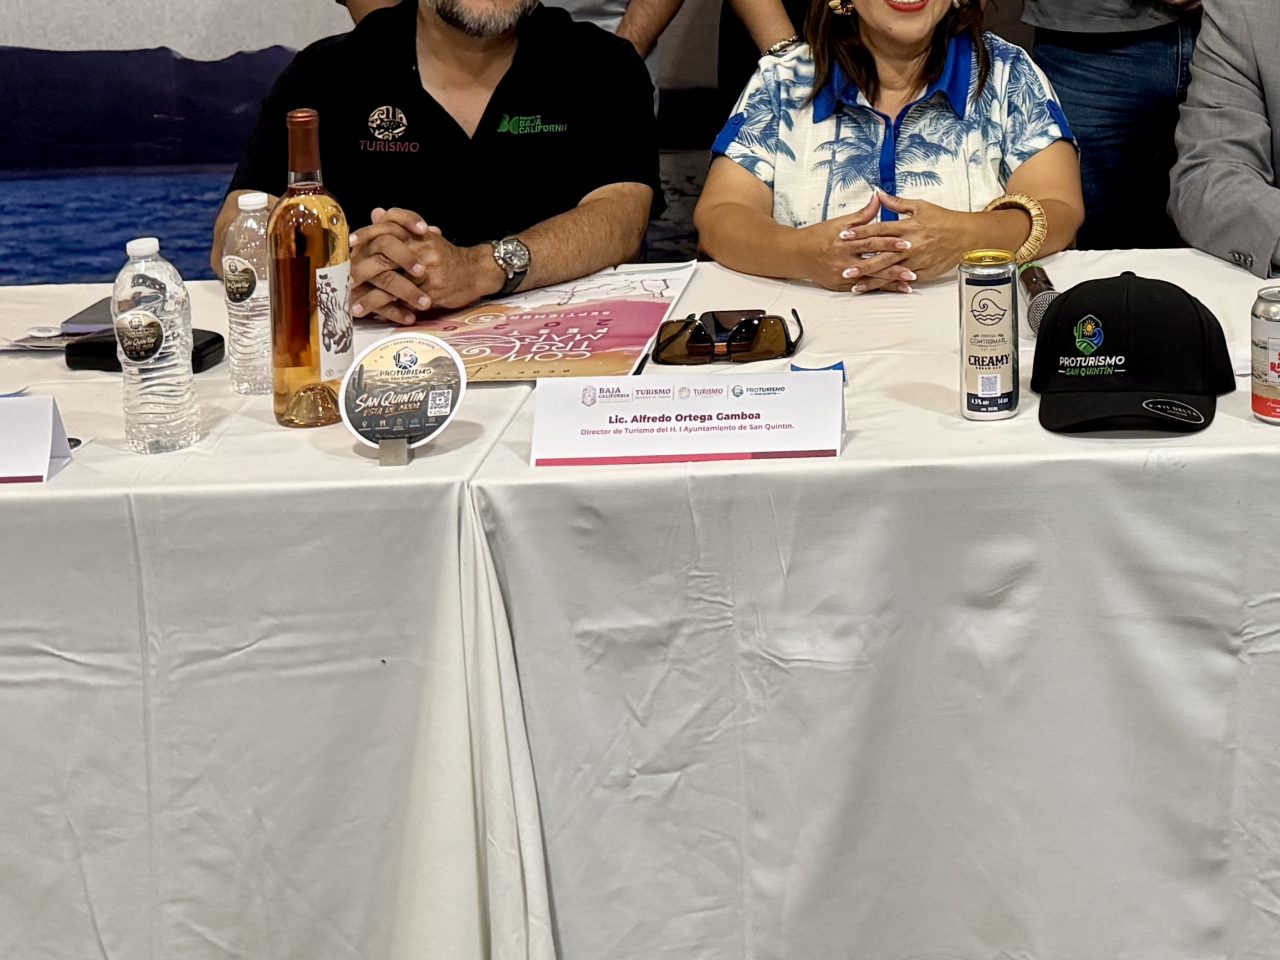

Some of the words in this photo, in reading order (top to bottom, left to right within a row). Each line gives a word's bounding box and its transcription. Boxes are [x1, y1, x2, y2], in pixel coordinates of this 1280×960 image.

[519, 119, 542, 127] BAJA
[359, 140, 420, 153] TURISMO
[500, 311, 611, 322] SEPTIEMBRE
[510, 327, 609, 337] FEST
[968, 353, 1010, 367] CREAMY
[1059, 355, 1126, 367] PROTURISMO
[1066, 367, 1080, 376] SAN
[1080, 366, 1114, 377] QUINTÍN
[355, 393, 381, 413] SAN
[609, 415, 628, 424] Lic.
[631, 414, 672, 423] Alfredo
[675, 413, 713, 423] Ortega
[716, 411, 761, 421] Gamboa
[580, 428, 611, 436] Director
[683, 425, 736, 433] Ayuntamiento
